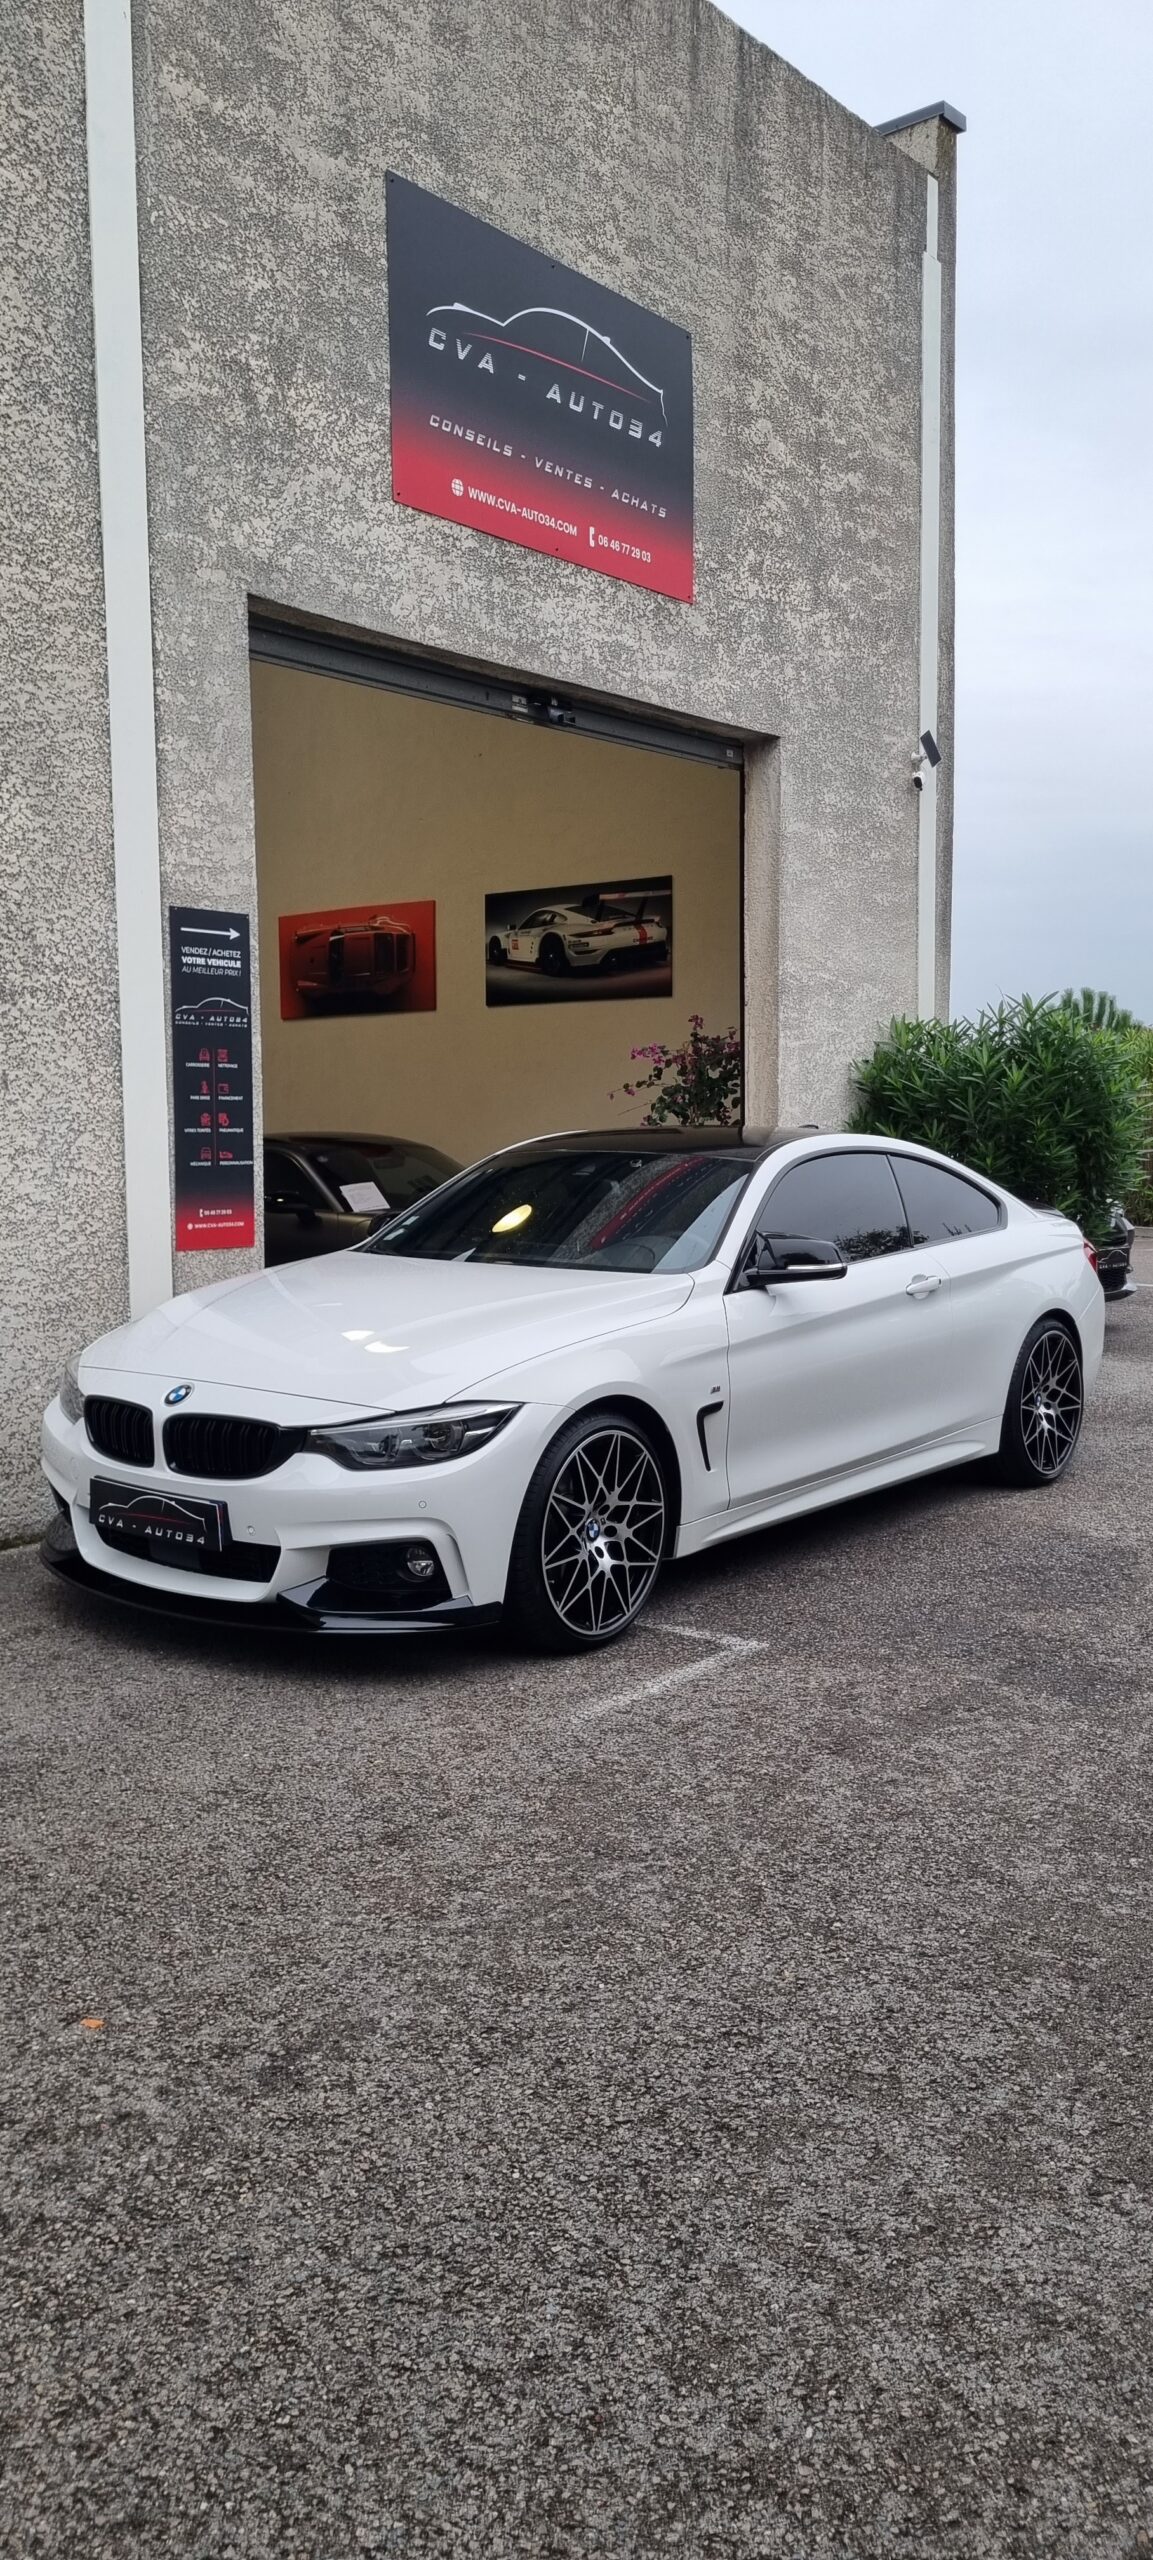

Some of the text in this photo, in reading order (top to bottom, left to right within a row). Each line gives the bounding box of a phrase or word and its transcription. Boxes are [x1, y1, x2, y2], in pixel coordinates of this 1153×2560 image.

[428, 327, 495, 374] CVA
[545, 383, 662, 447] AUTO34
[429, 414, 513, 457] CONSEILS
[534, 456, 593, 489] VENTES
[610, 488, 667, 518] ACHATS
[467, 485, 578, 537] WWW.CVA-AUTO34.COM
[598, 534, 651, 563] 06 46 77 29 03
[181, 946, 208, 956] VENDEZ
[212, 948, 242, 958] ACHETEZ
[181, 956, 206, 965] VOTRE
[181, 965, 192, 973] AU
[192, 966, 224, 976] MEILLEUR
[98, 1514, 124, 1528] CVA
[144, 1525, 205, 1545] AUTO34
